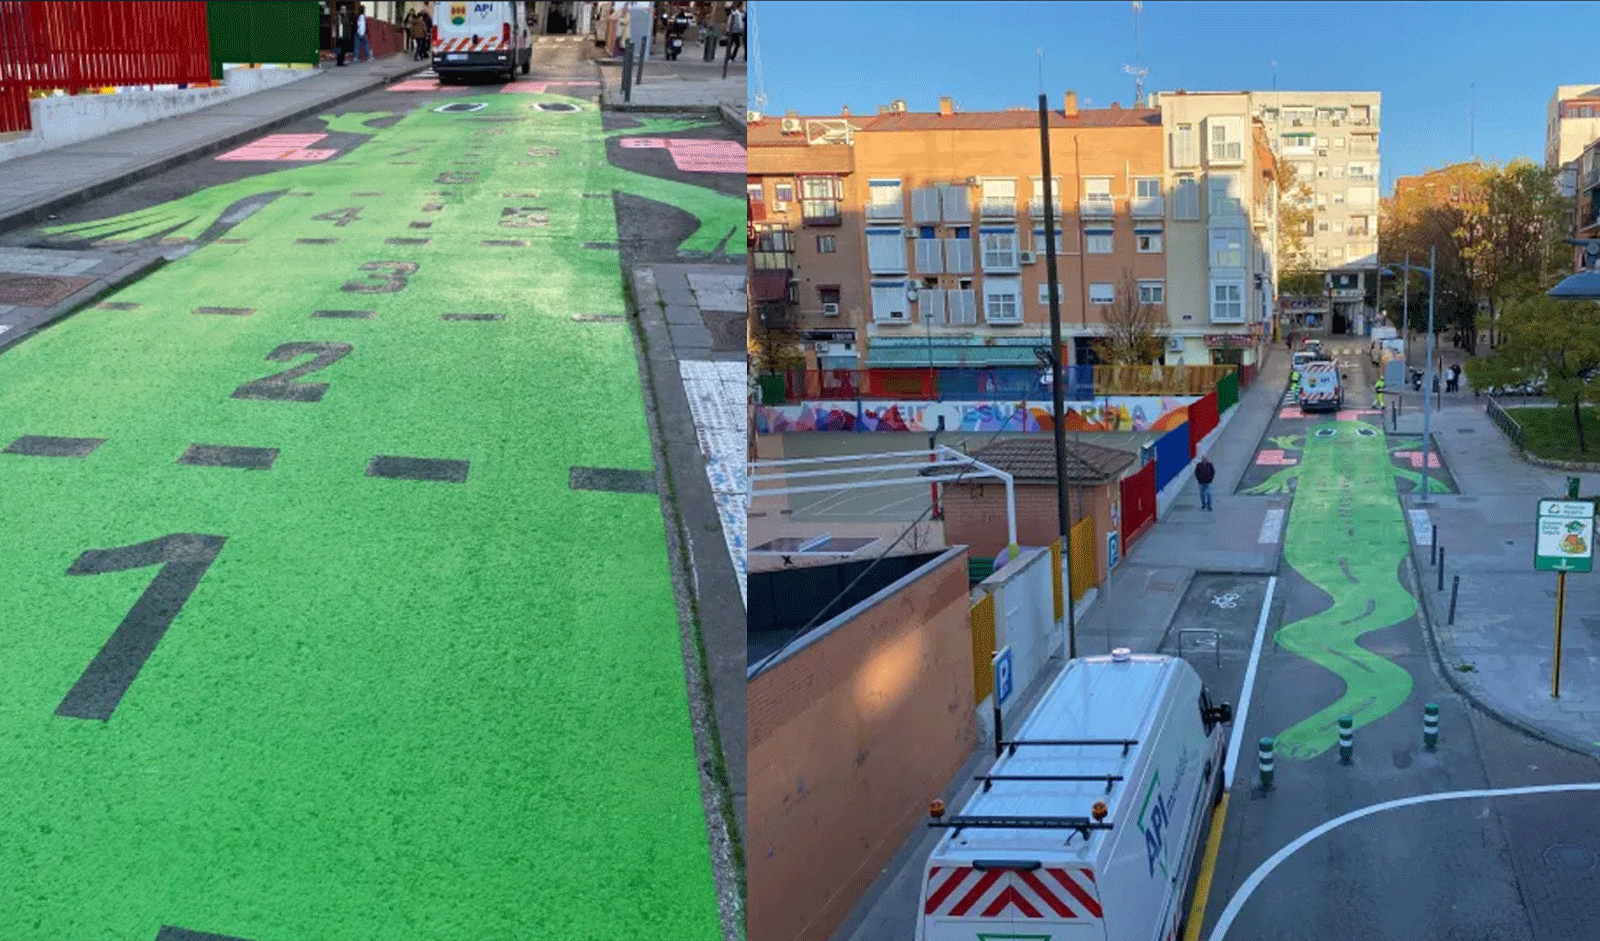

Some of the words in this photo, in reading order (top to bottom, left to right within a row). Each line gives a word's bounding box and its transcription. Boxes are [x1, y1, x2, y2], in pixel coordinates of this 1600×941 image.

[474, 4, 493, 12] API
[312, 205, 364, 227] 4
[499, 206, 549, 228] 5
[340, 261, 420, 294] 3
[230, 341, 355, 402] 2
[1110, 538, 1118, 565] P
[53, 532, 229, 722] 1
[998, 660, 1009, 699] P
[1145, 793, 1169, 879] API
